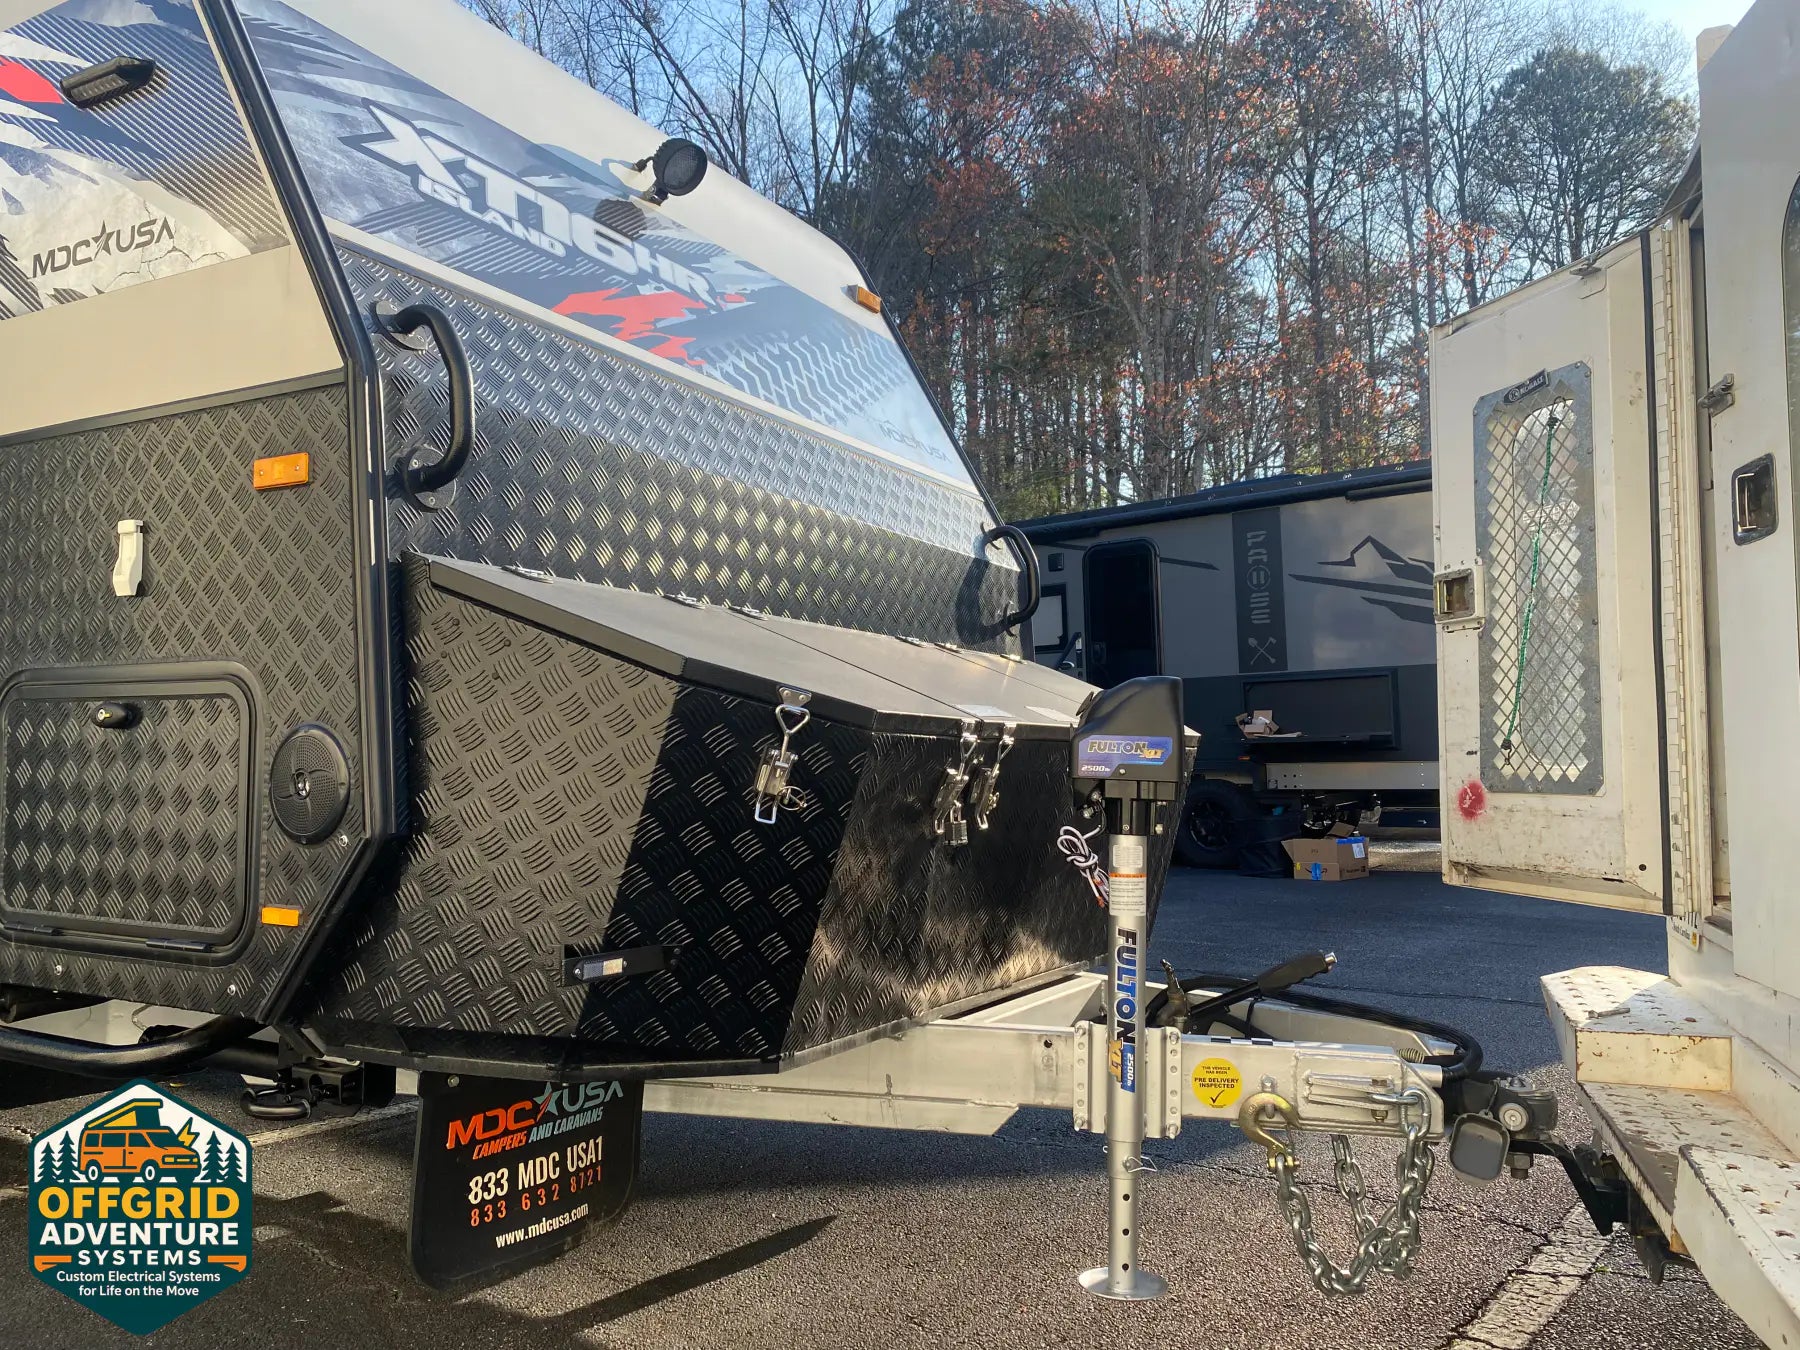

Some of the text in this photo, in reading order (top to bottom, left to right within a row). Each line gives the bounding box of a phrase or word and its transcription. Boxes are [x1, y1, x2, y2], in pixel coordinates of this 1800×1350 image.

[32, 216, 175, 279] MDC USA
[418, 174, 567, 258] ISLAND
[1088, 740, 1148, 754] FULTON
[1115, 926, 1139, 1046] FULTON
[446, 1080, 624, 1150] MDC USA
[472, 1106, 604, 1160] CAMPERS AND CARAVANS
[468, 1135, 603, 1205] 833 MDC USA1
[570, 1165, 602, 1193] 8721
[495, 1202, 589, 1249] www.mdcusa.com
